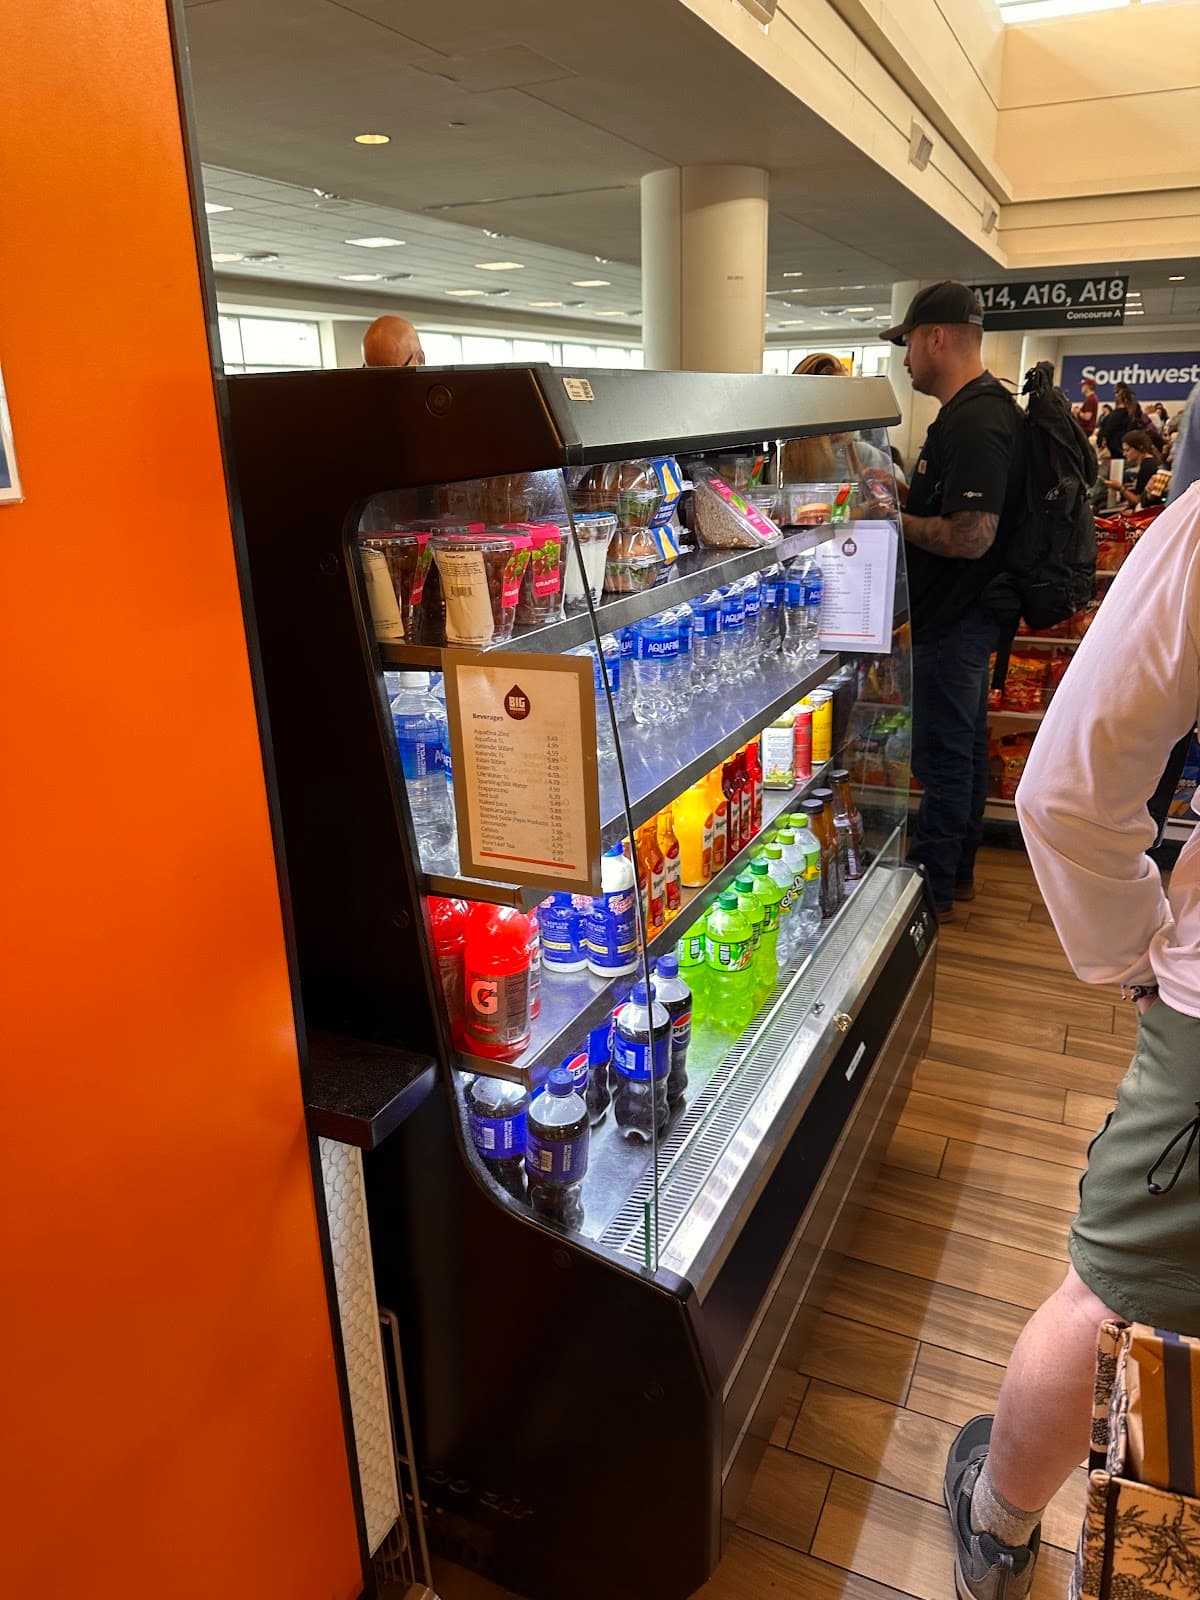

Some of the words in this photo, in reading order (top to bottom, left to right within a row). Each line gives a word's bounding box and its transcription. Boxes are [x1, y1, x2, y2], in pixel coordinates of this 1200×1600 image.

[974, 285, 1016, 309] A14,
[1022, 283, 1072, 306] A16,
[1079, 280, 1124, 302] A18
[1066, 310, 1112, 320] Concourse
[1113, 310, 1121, 318] A
[1081, 363, 1200, 386] Southwest
[508, 696, 525, 708] BIG
[472, 712, 503, 721] Beverages
[471, 980, 498, 1015] G
